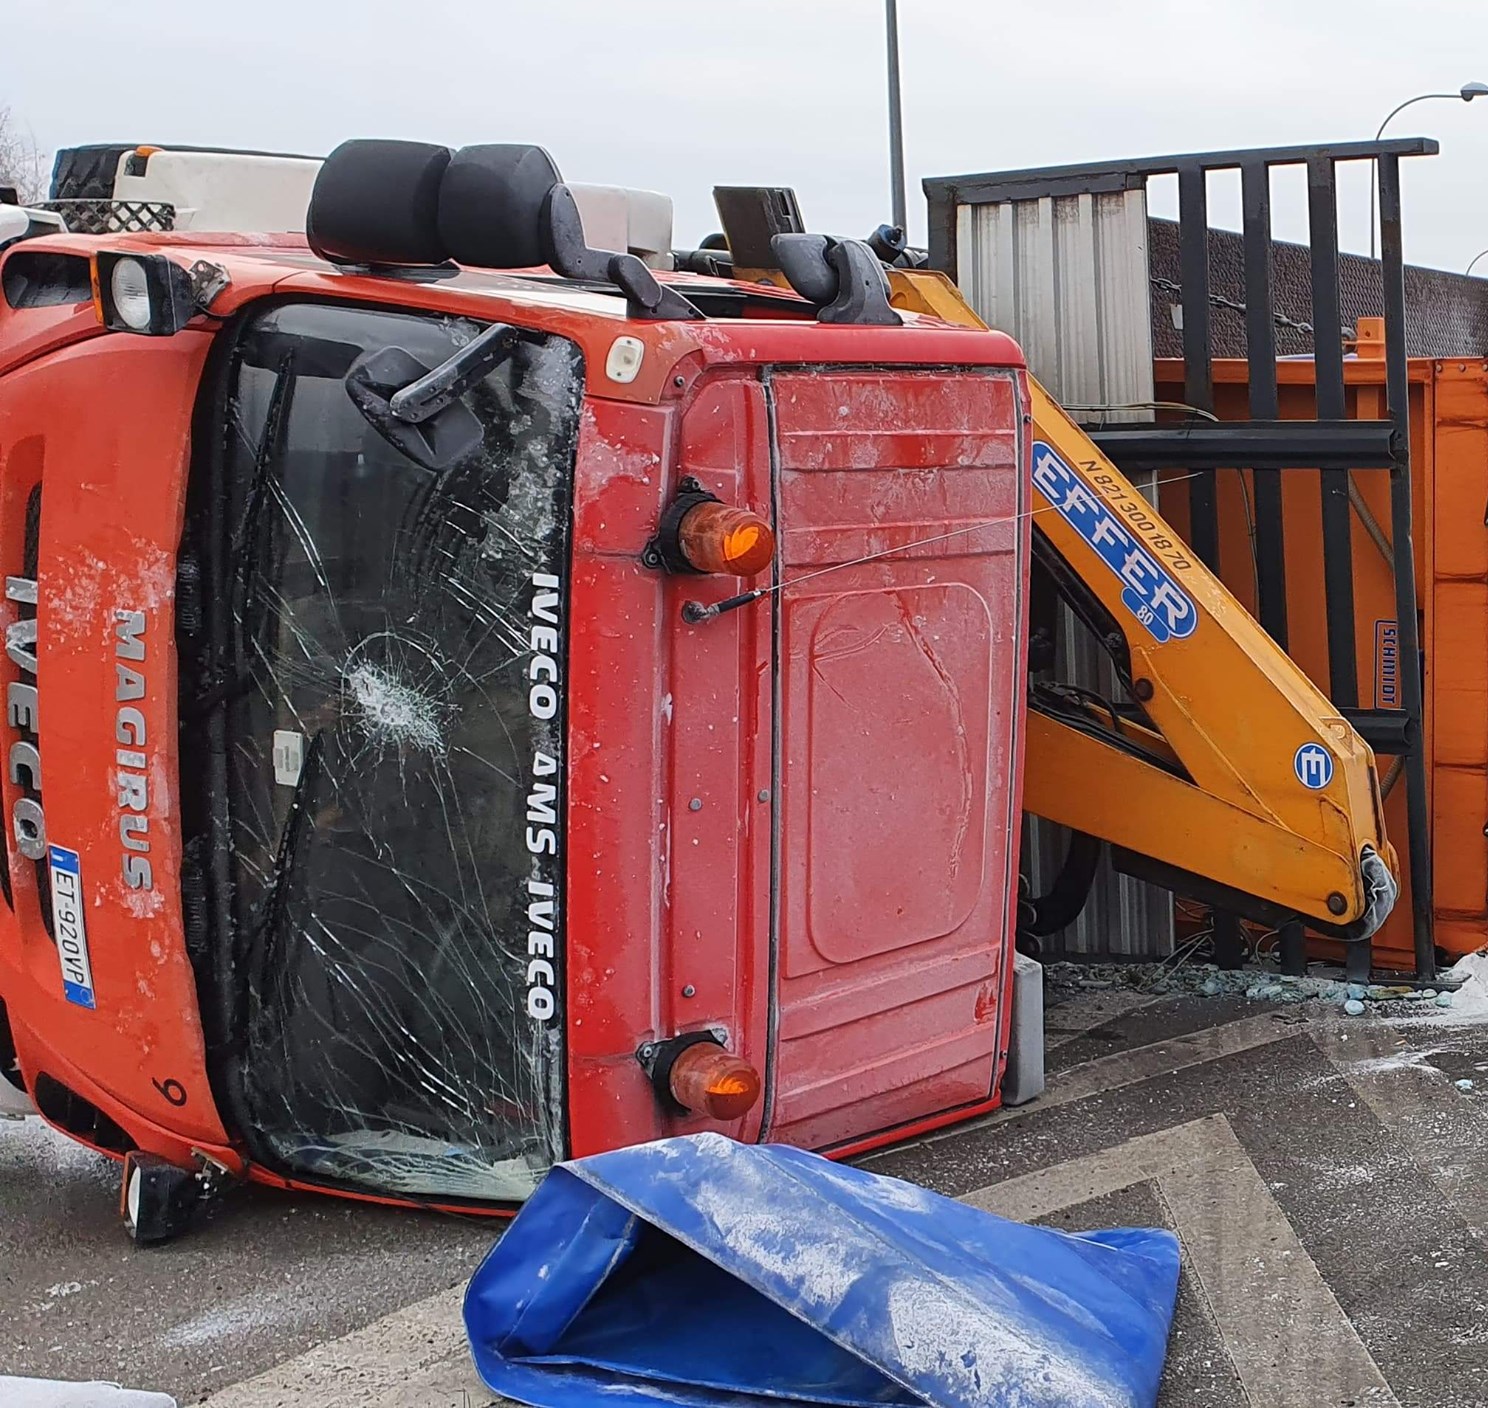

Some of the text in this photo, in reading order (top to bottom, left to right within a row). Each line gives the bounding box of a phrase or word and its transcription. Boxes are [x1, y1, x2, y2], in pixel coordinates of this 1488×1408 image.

[1033, 452, 1189, 631] EFFER
[1078, 460, 1192, 571] N 821 300 18 70
[1136, 605, 1154, 626] 80
[1382, 628, 1397, 704] SCHMIDT
[5, 576, 47, 860] IVECO
[114, 608, 154, 891] MAGIRUS
[525, 572, 560, 1021] IVECO AMS IVECO
